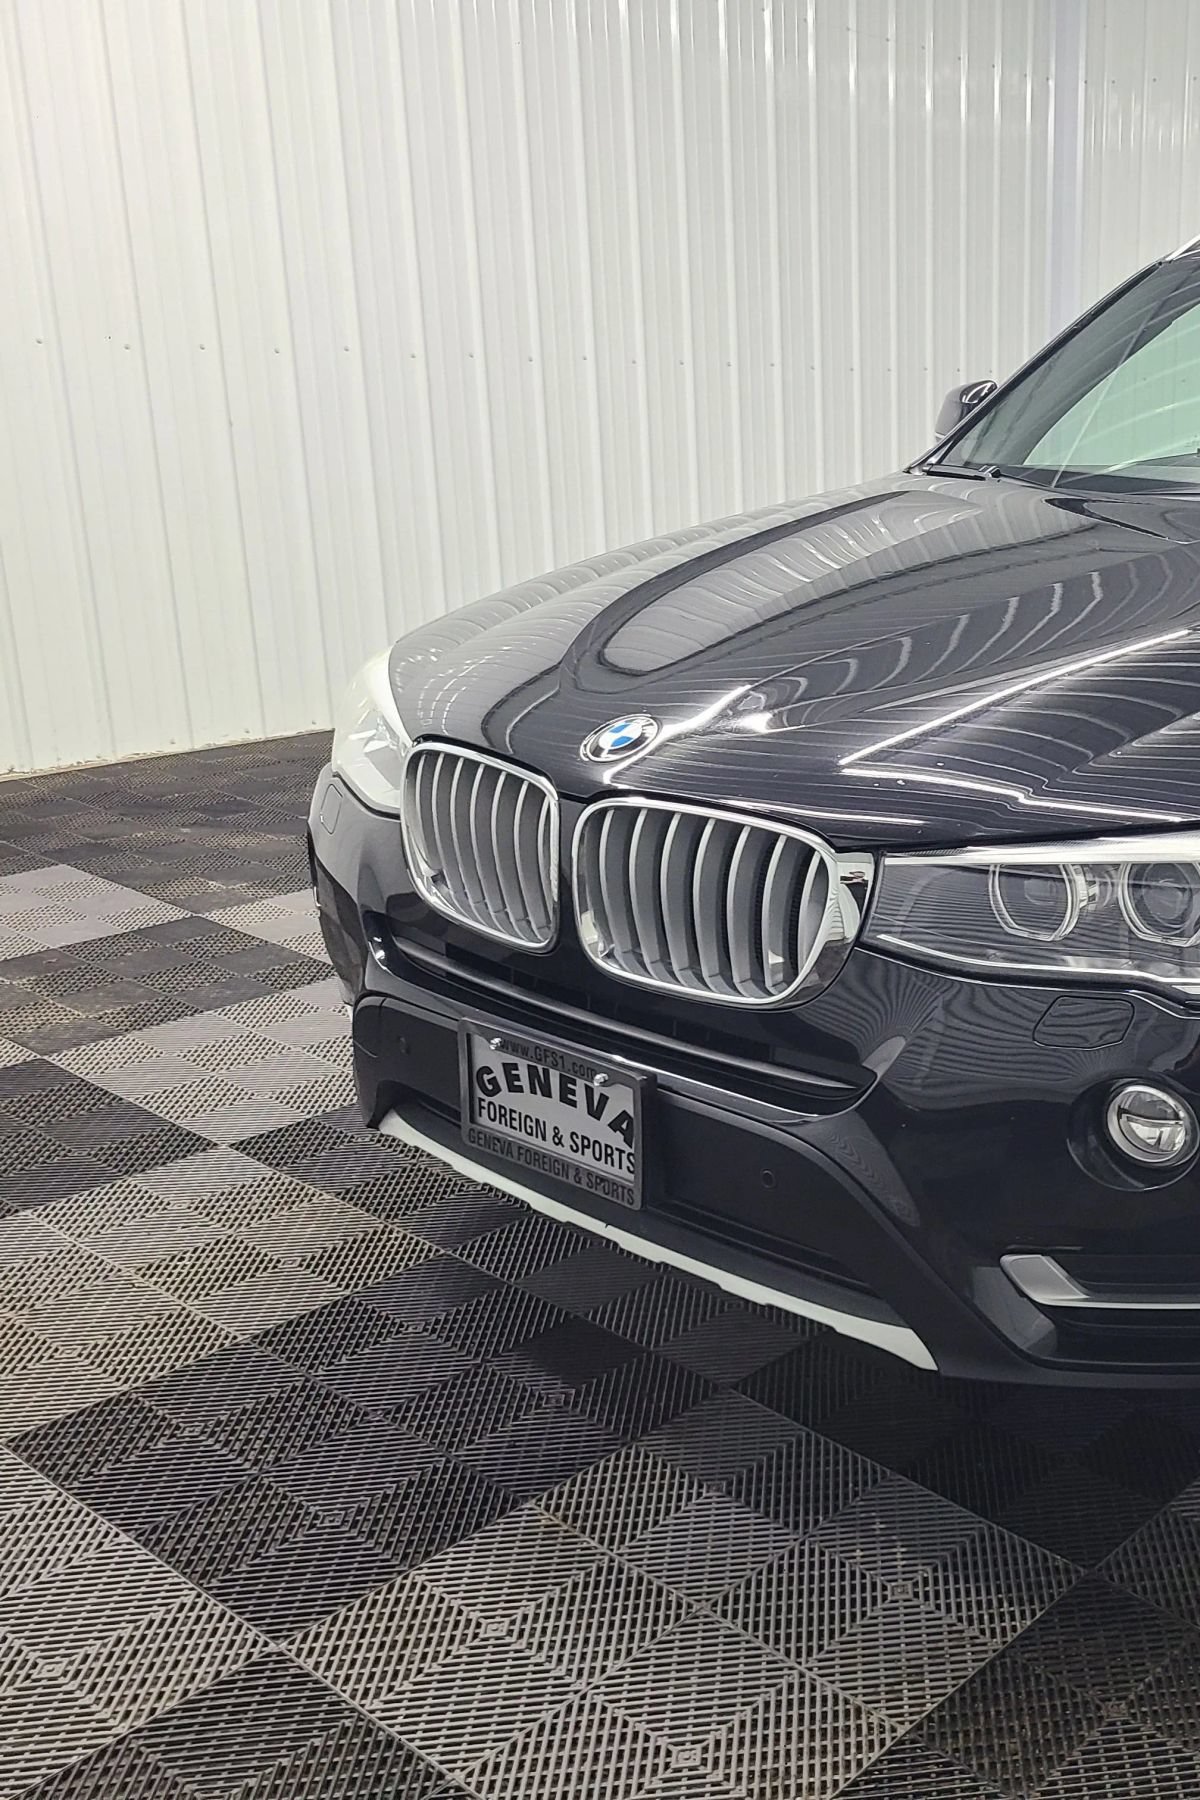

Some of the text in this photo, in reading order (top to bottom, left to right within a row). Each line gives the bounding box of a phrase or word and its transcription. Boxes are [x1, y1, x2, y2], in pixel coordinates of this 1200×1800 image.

[476, 1062, 635, 1149] GENEVA
[477, 1097, 636, 1175] FOREIGN & SPORTS
[468, 1127, 635, 1206] GENEVA FOREIGN & SPORTS
